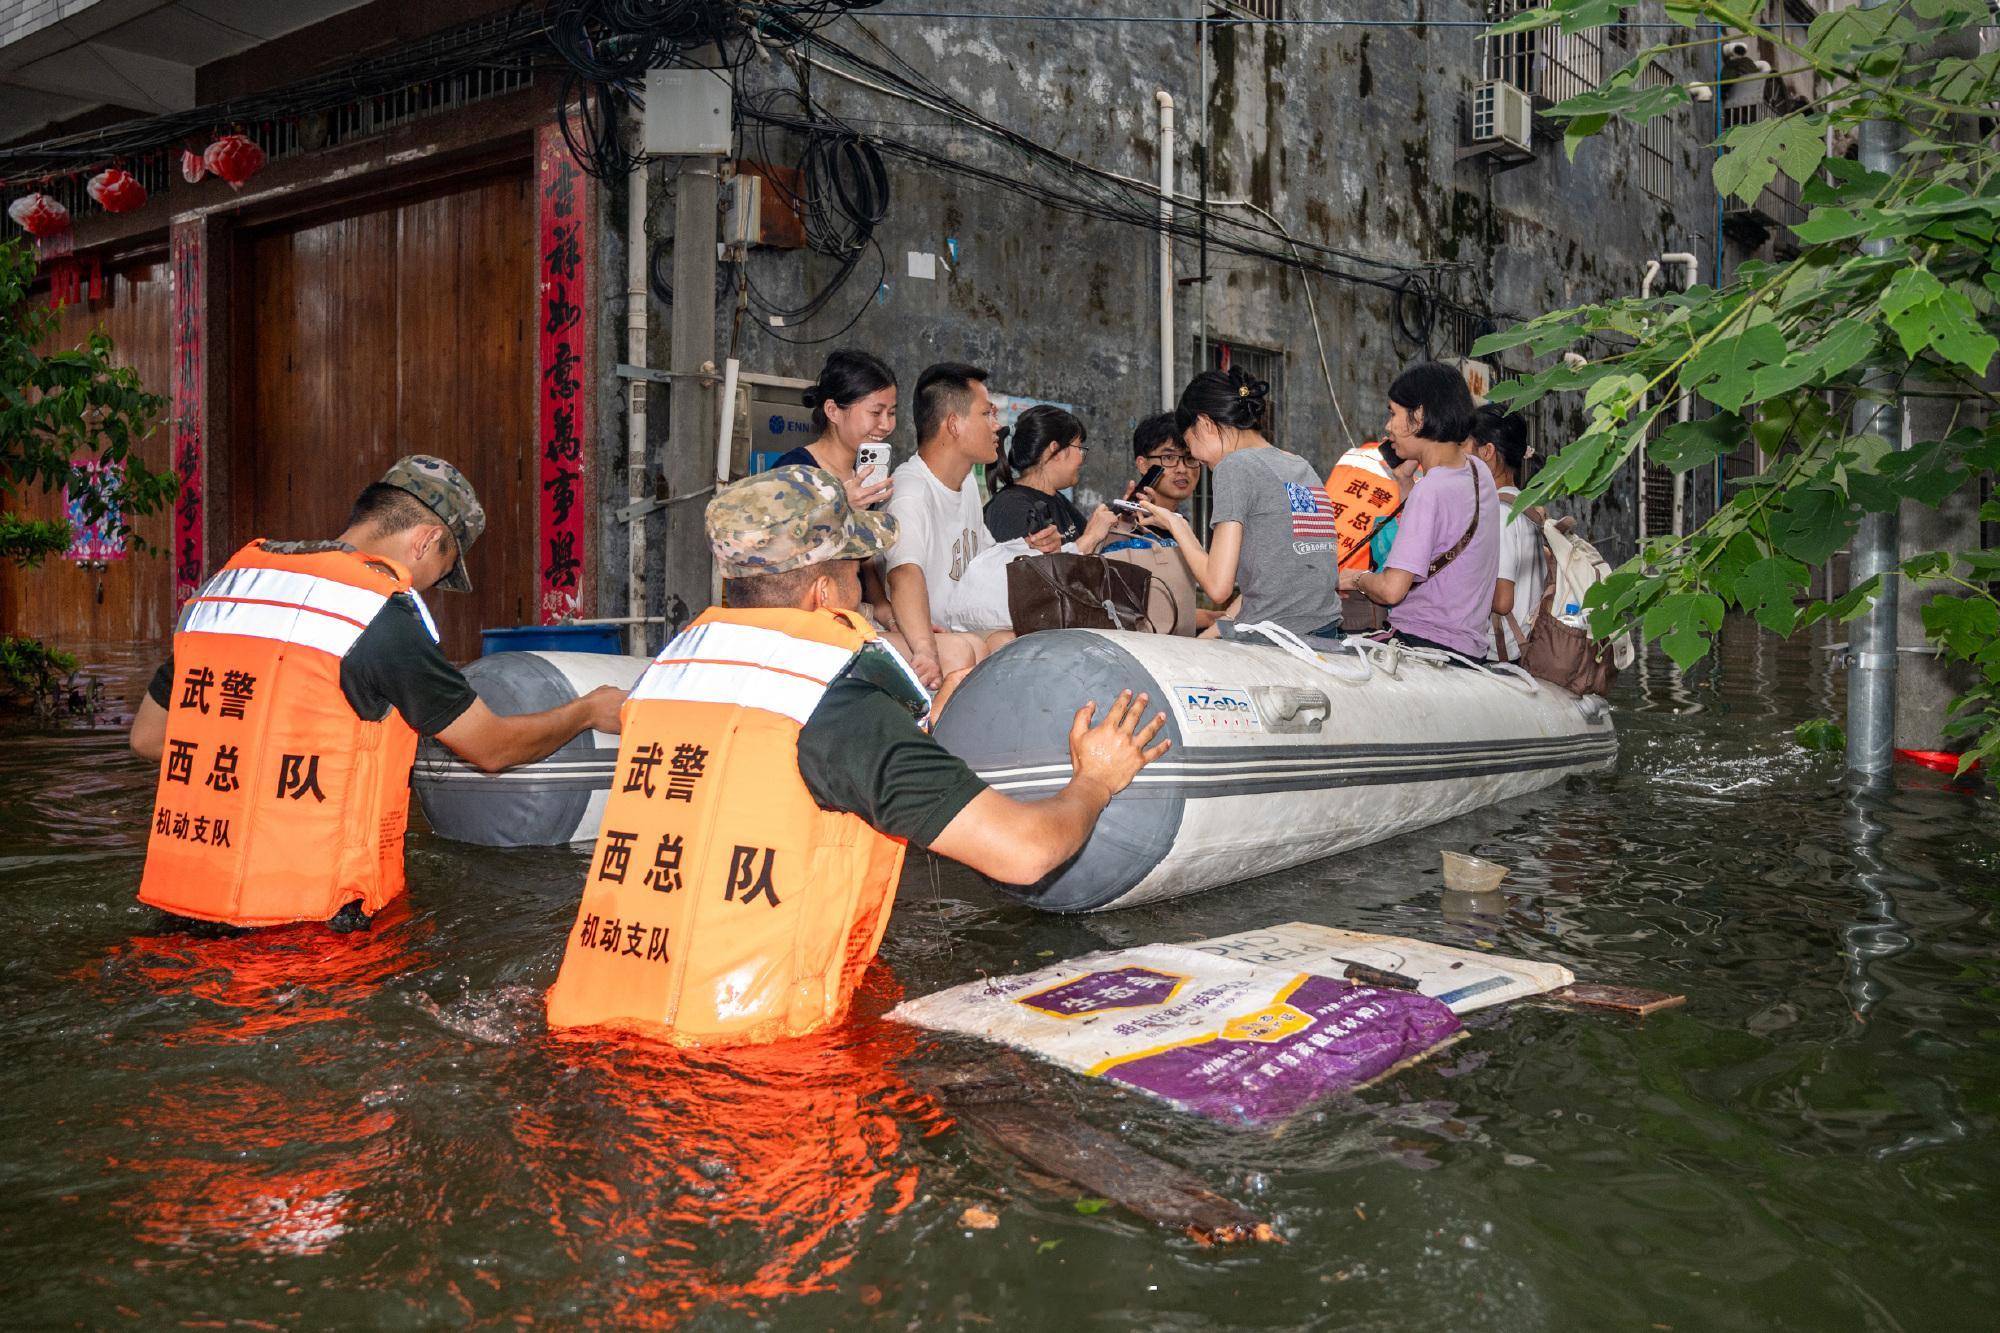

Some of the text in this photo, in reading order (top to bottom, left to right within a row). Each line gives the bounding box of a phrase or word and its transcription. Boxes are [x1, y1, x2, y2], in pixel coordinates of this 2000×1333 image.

[1344, 479, 1393, 508] 武警
[180, 667, 257, 720] 武警
[622, 742, 709, 803] 武警
[156, 807, 231, 848] 机动支队
[581, 913, 670, 964] 机动支队
